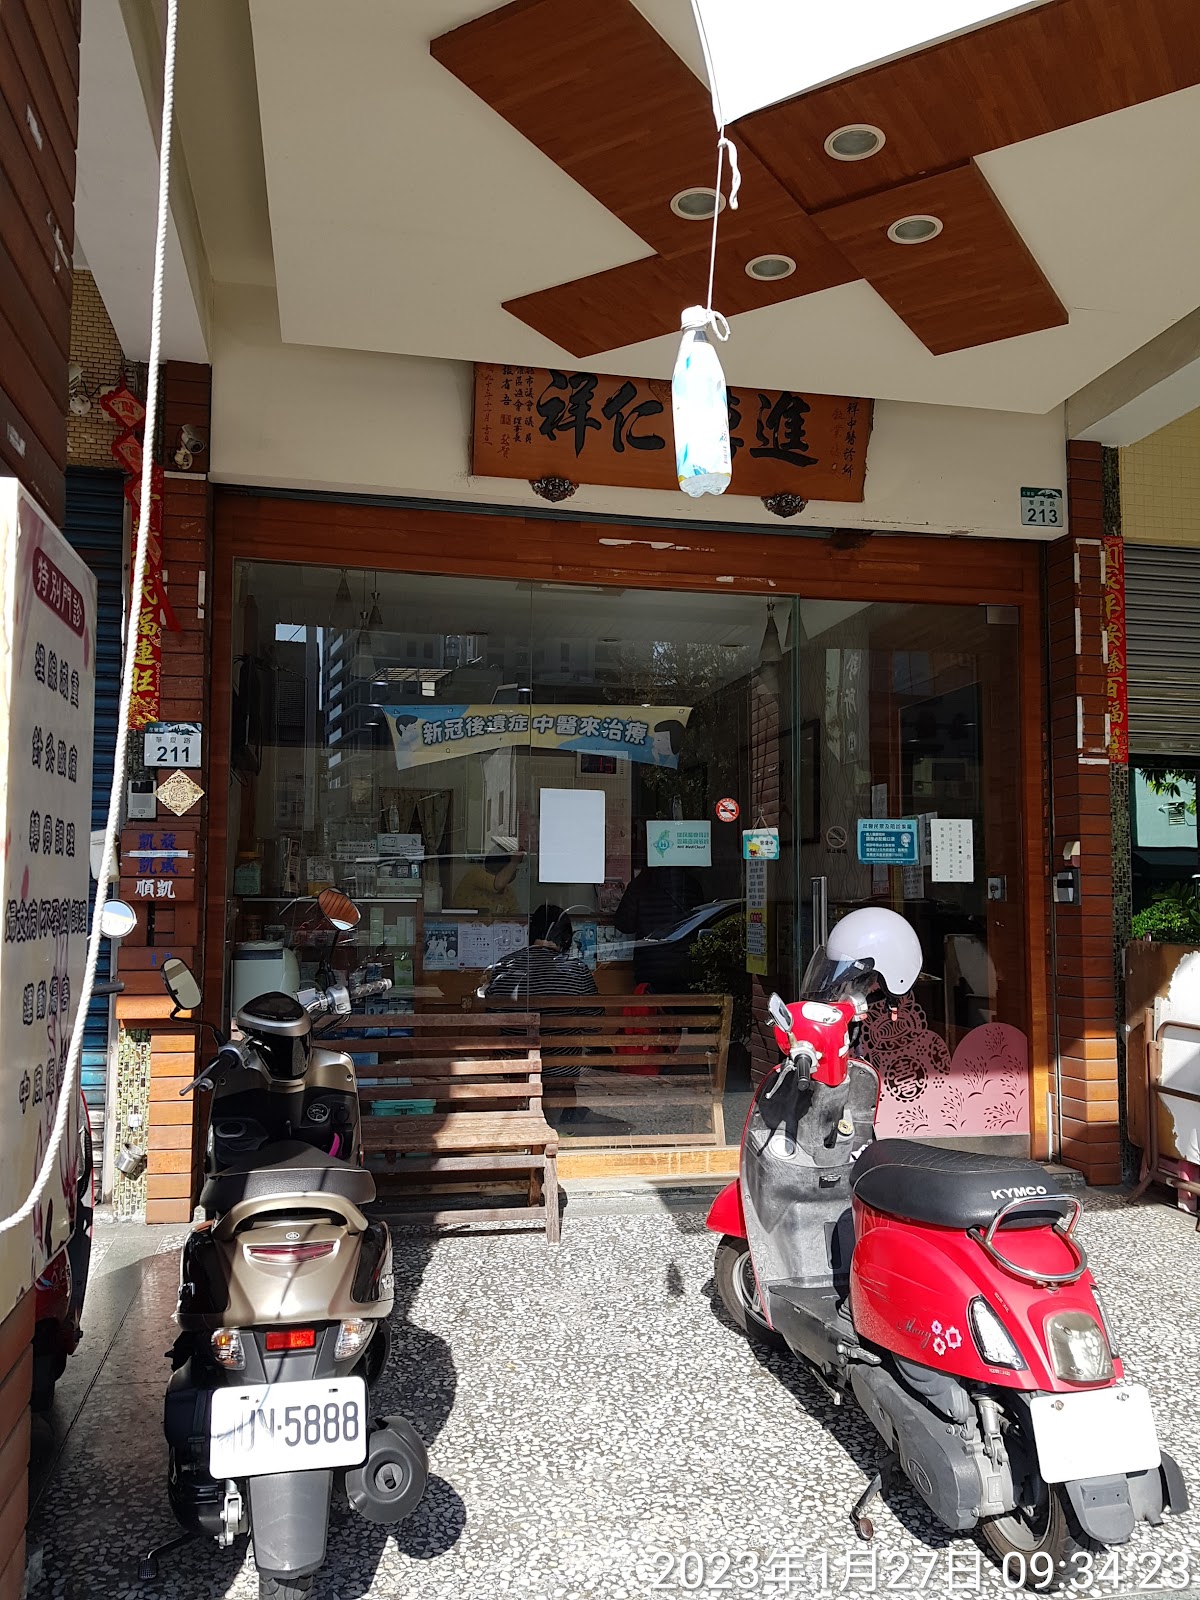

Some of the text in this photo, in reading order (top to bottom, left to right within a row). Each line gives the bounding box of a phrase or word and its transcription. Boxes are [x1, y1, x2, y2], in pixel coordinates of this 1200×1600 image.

[1028, 508, 1058, 524] 213
[37, 555, 83, 628] 特別門診
[157, 746, 190, 763] 211
[990, 1185, 1048, 1200] KYMCO
